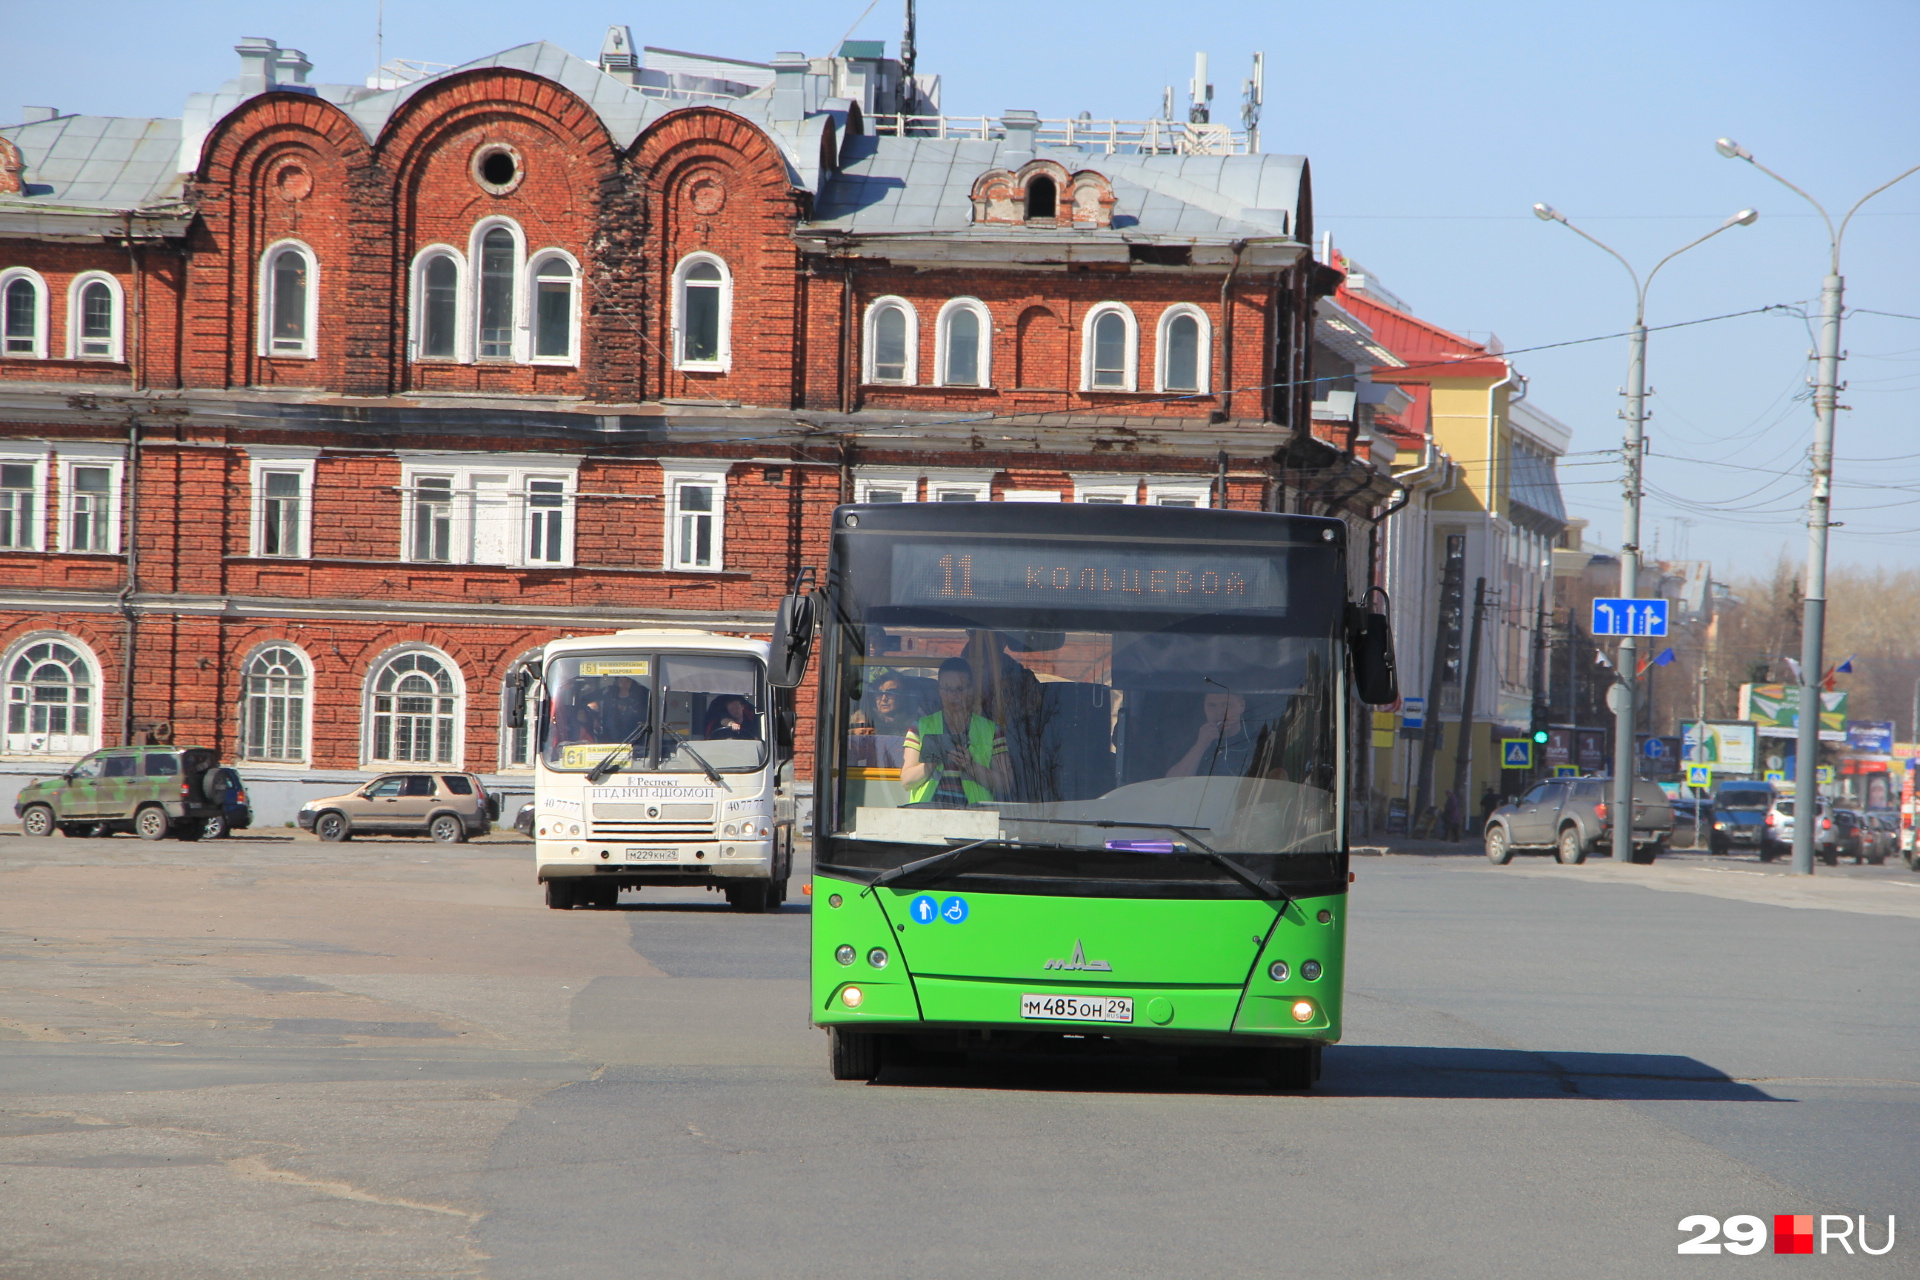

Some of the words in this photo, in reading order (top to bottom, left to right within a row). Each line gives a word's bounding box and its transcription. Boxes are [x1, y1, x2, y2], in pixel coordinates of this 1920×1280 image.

[939, 554, 974, 596] 11
[1026, 565, 1245, 596] КОЛЬЦЕВОЙ
[586, 663, 597, 673] 61
[1554, 735, 1562, 747] 1
[566, 749, 583, 765] 61
[637, 777, 680, 786] Респект
[667, 850, 676, 858] 29
[1028, 998, 1102, 1017] М485ОН
[1108, 1000, 1126, 1013] 29
